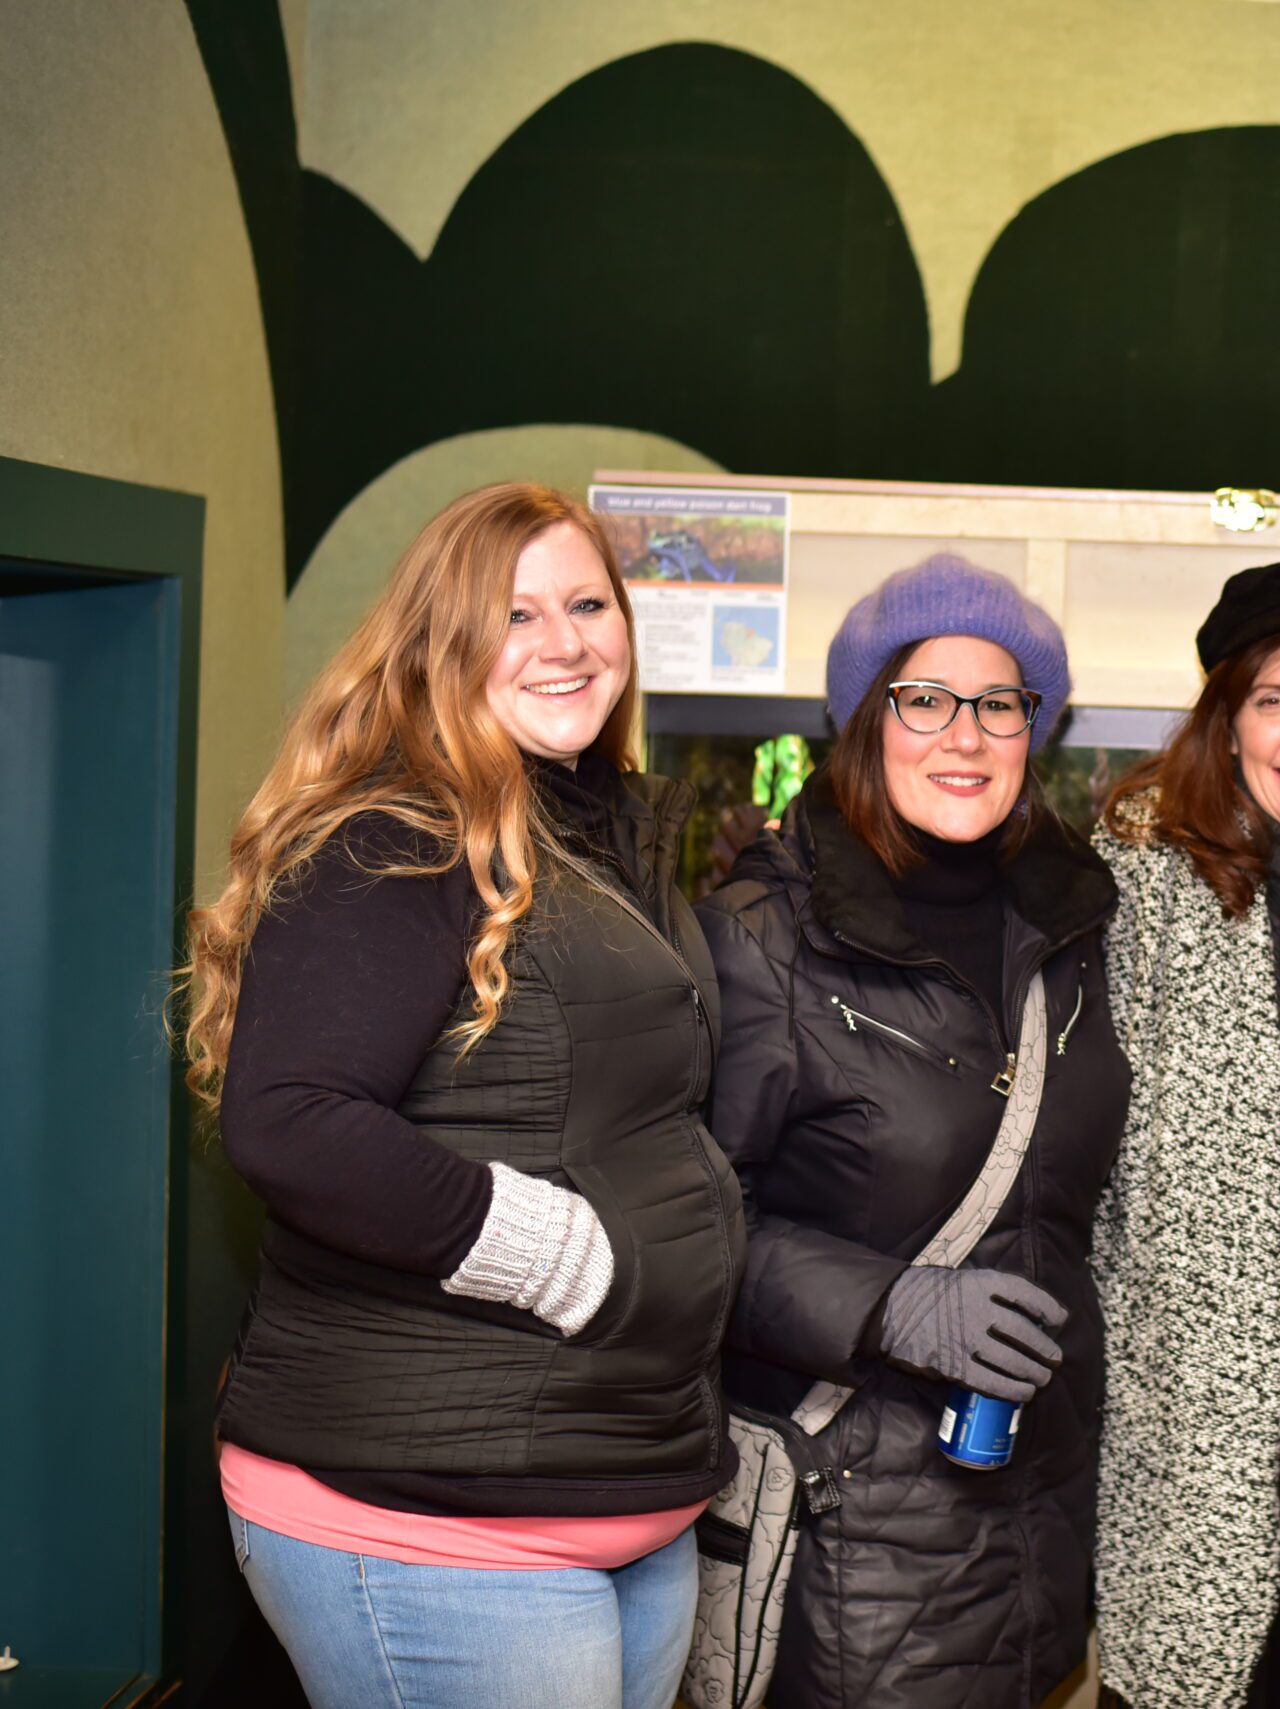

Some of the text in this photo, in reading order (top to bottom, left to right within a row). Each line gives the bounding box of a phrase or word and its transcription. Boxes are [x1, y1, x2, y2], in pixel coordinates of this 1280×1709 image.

[633, 498, 653, 509] and
[654, 498, 687, 511] yellow
[749, 501, 772, 514] frog
